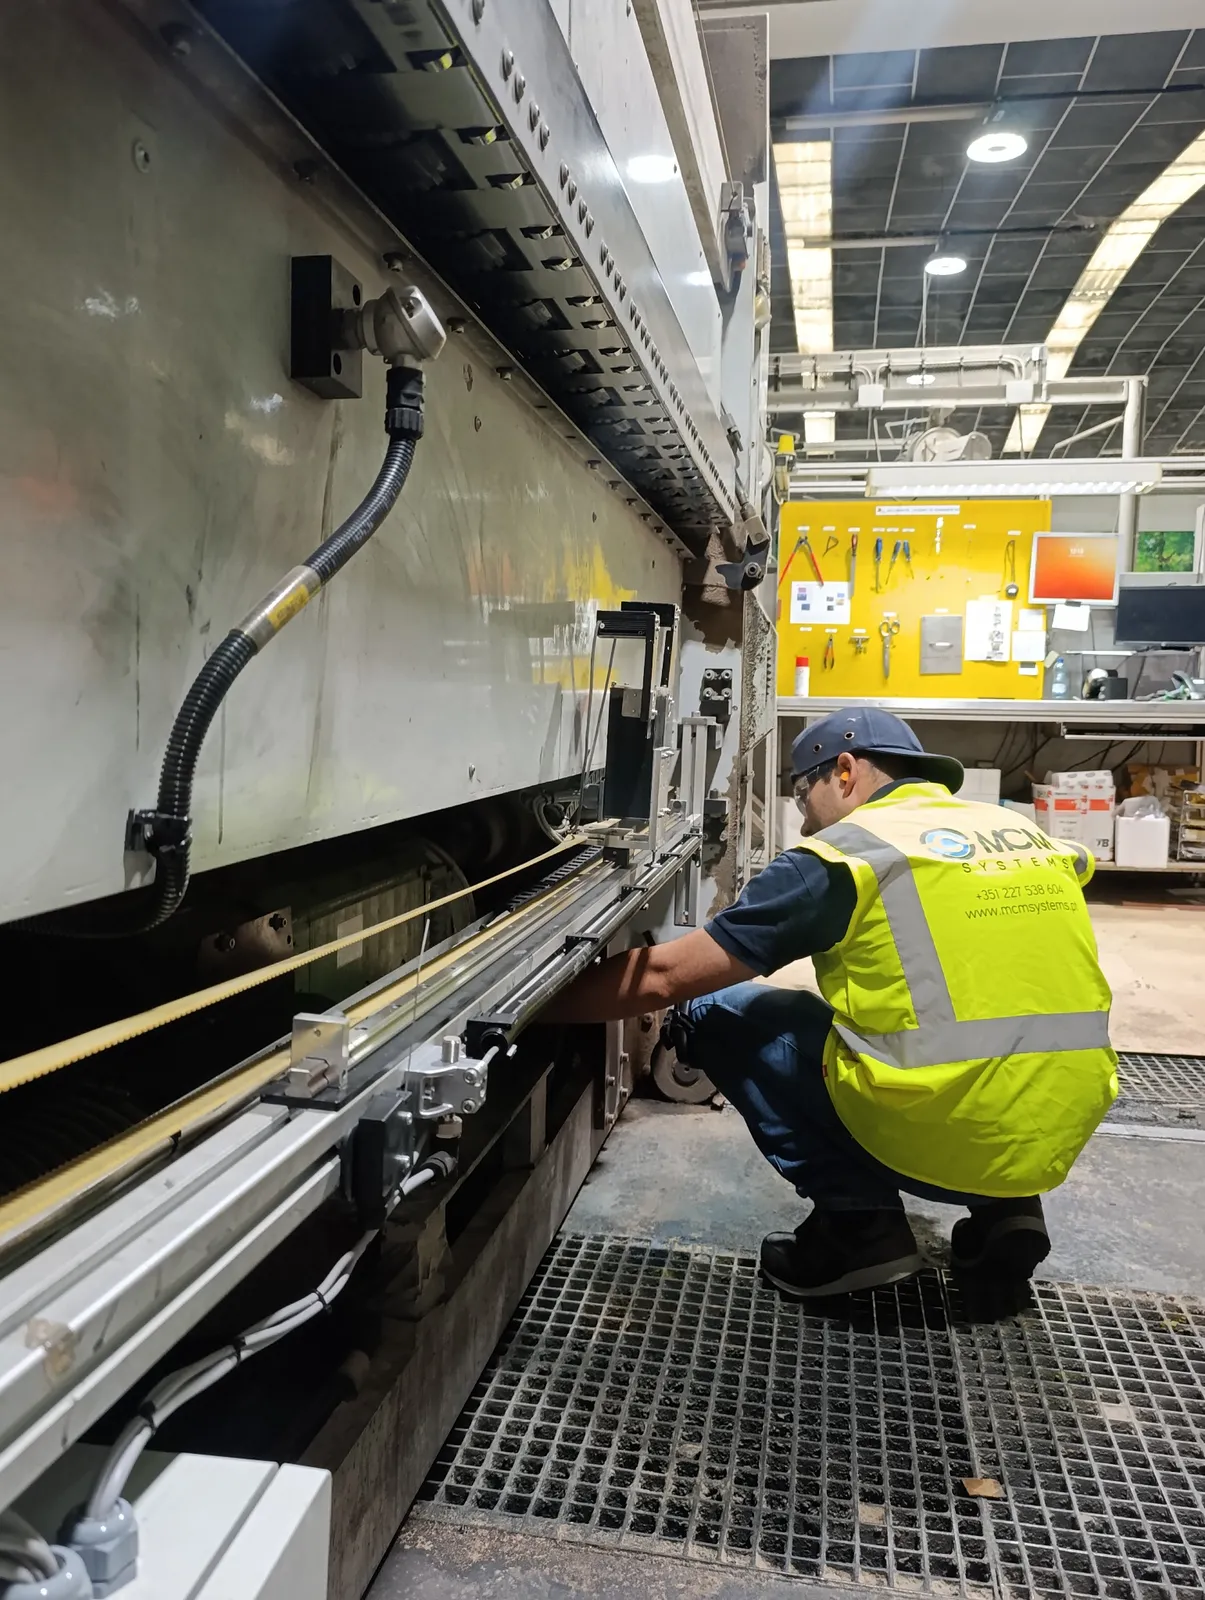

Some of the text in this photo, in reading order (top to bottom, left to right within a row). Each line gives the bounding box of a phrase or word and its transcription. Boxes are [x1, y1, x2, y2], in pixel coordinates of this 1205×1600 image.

[973, 827, 1059, 854] MCM
[962, 857, 1069, 874] SYSTEMS
[976, 883, 1064, 901] +351 227 538 604
